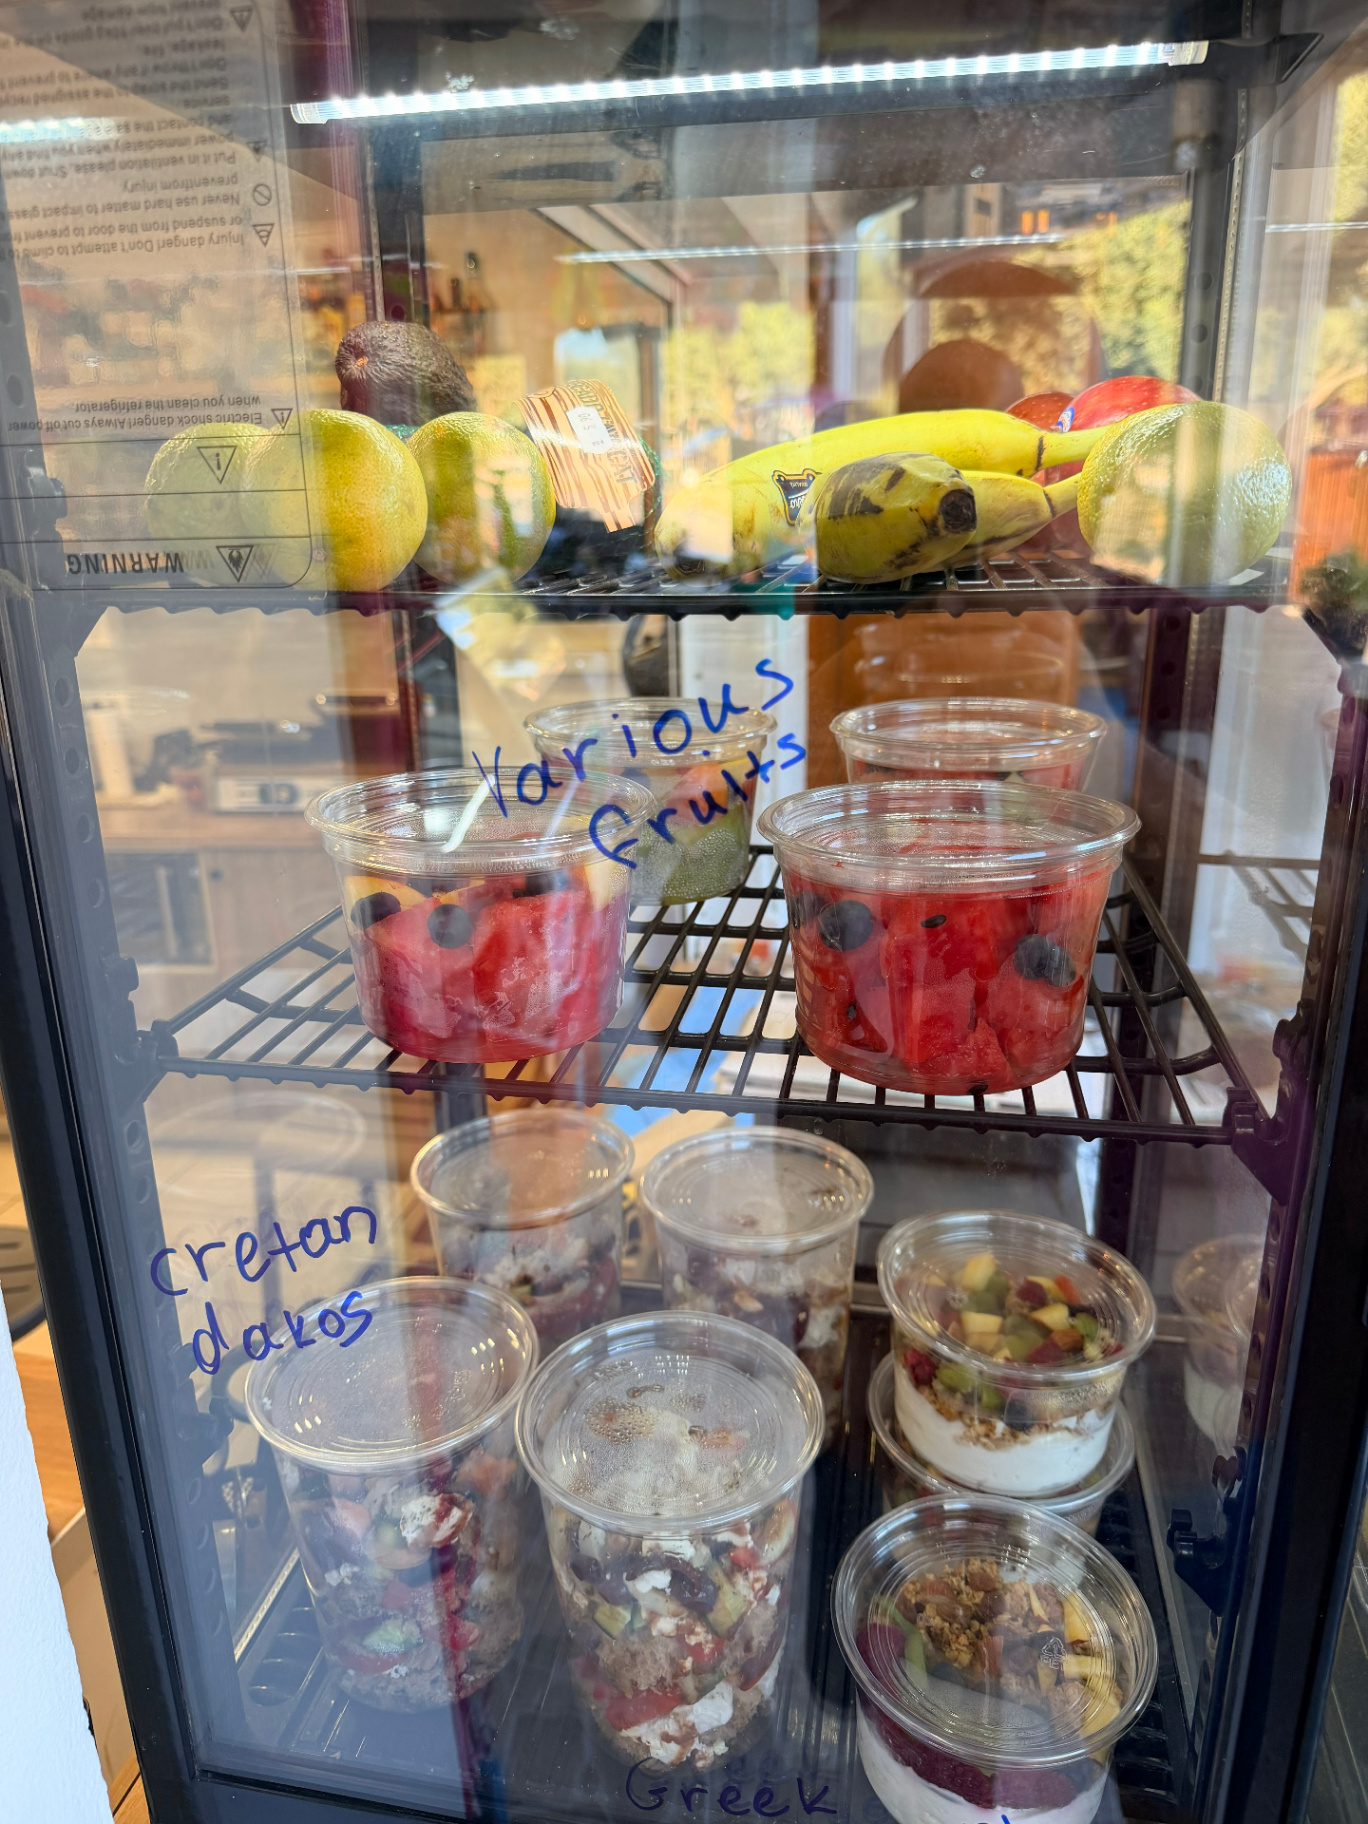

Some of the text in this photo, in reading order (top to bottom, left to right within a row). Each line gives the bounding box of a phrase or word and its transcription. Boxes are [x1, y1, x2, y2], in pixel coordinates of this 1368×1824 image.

[194, 76, 228, 89] Send
[34, 88, 90, 105] assigned
[113, 135, 191, 153] immediately
[194, 131, 234, 146] power
[119, 154, 185, 172] ventilation
[188, 154, 200, 168] in
[202, 154, 211, 166] it
[213, 150, 236, 164] Put
[4, 166, 35, 180] down
[38, 164, 68, 178] Shut
[144, 197, 172, 212] hard
[176, 195, 198, 209] use
[202, 192, 240, 206] Never
[42, 203, 83, 219] impact
[85, 203, 98, 215] to
[101, 200, 141, 216] matter
[141, 220, 169, 233] from
[173, 214, 226, 233] suspend
[230, 214, 242, 226] or
[24, 226, 70, 242] prevent
[73, 226, 85, 238] to
[88, 224, 115, 238] door
[118, 222, 138, 235] the
[121, 238, 153, 253] Don't
[156, 233, 205, 251] danger!
[208, 231, 244, 246] Injury
[57, 244, 69, 255] to
[71, 239, 118, 254] attempt
[144, 399, 164, 413] the
[167, 397, 199, 412] clean
[203, 394, 224, 410] you
[227, 395, 261, 410] when
[8, 412, 262, 434] Electric shock danger! Always cut off power
[66, 552, 183, 574] WARNING
[471, 657, 794, 818] Various
[150, 1205, 377, 1296] cretan
[192, 1290, 373, 1375] dakos
[625, 1756, 838, 1818] Greek
